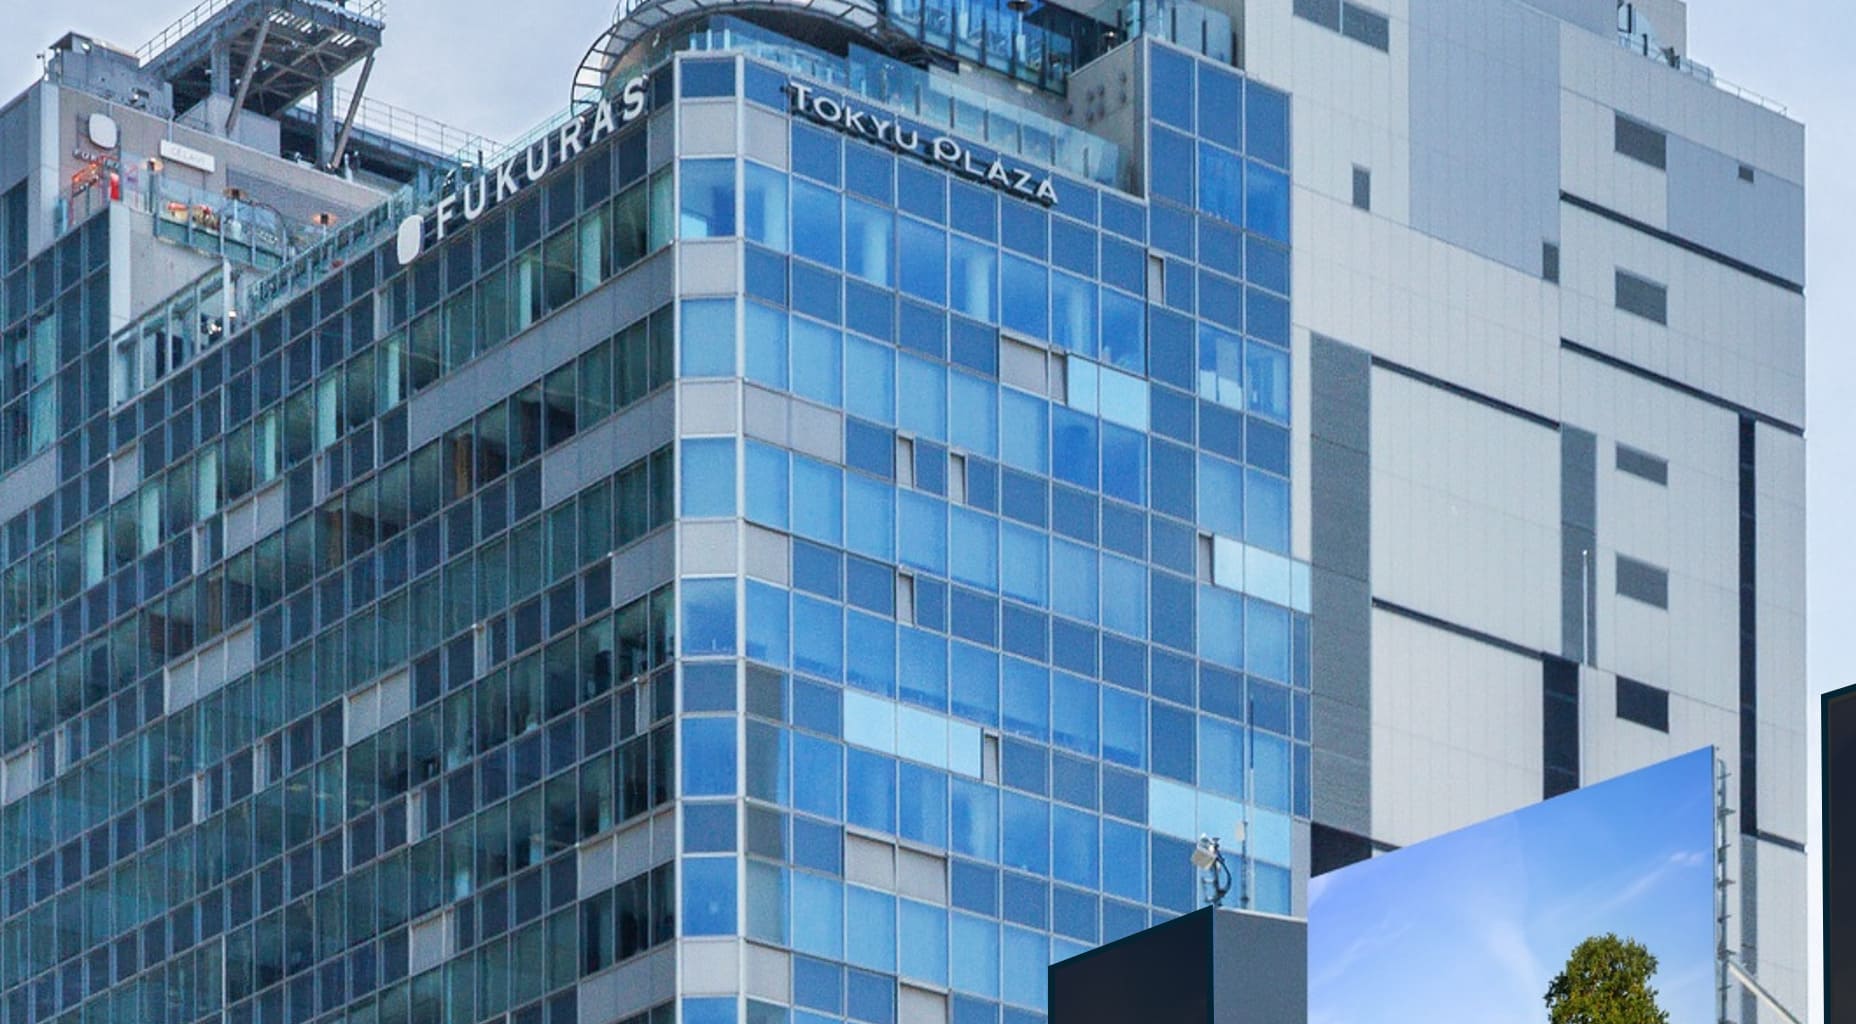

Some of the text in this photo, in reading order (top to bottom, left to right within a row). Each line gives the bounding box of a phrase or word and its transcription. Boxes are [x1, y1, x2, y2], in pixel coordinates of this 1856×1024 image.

[437, 76, 646, 239] FUKURAS
[790, 82, 1058, 203] TOKYU PLAZA
